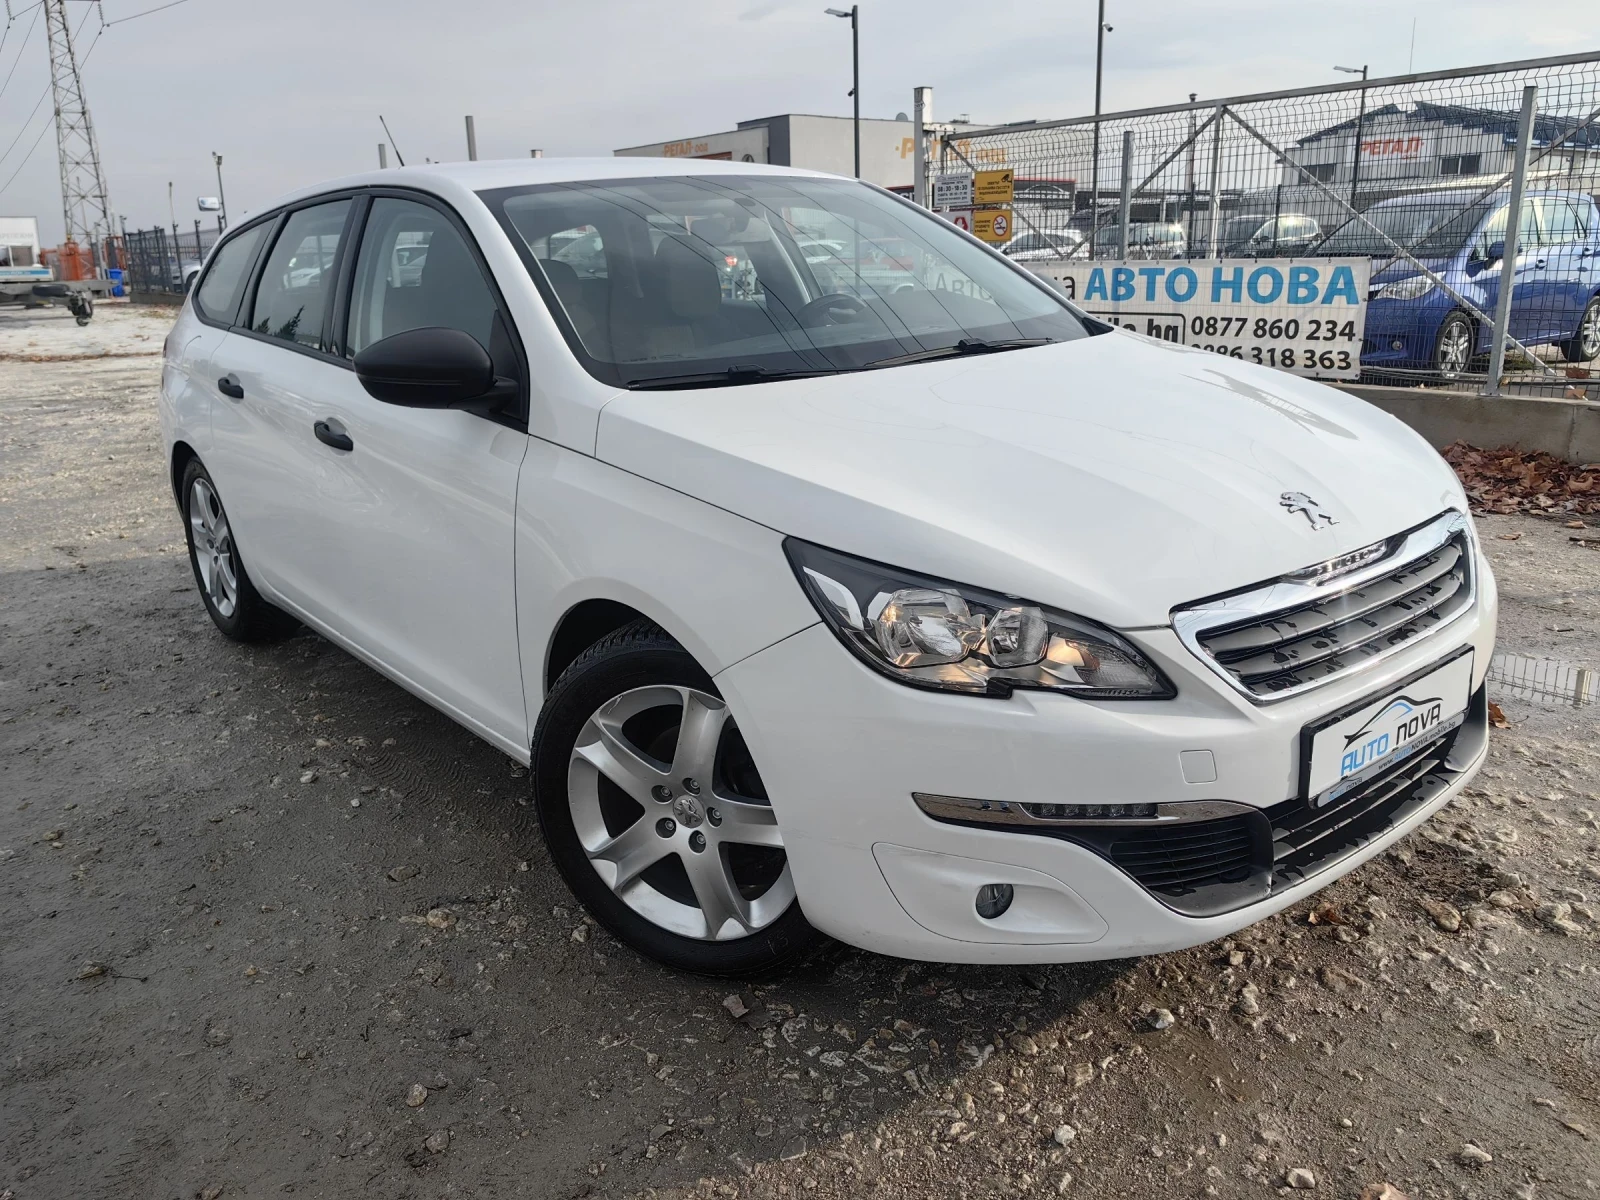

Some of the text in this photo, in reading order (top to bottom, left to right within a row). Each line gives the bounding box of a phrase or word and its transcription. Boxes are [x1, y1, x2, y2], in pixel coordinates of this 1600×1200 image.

[1360, 137, 1421, 155] РЕГАЛ
[1084, 266, 1199, 301] АВТО
[1210, 266, 1359, 305] НОВА
[1191, 316, 1248, 338] 0877
[1253, 318, 1299, 340] 860
[1306, 319, 1356, 342] 234
[1250, 347, 1296, 368] 318
[1303, 350, 1351, 371] 363
[1340, 733, 1389, 777] AUTO
